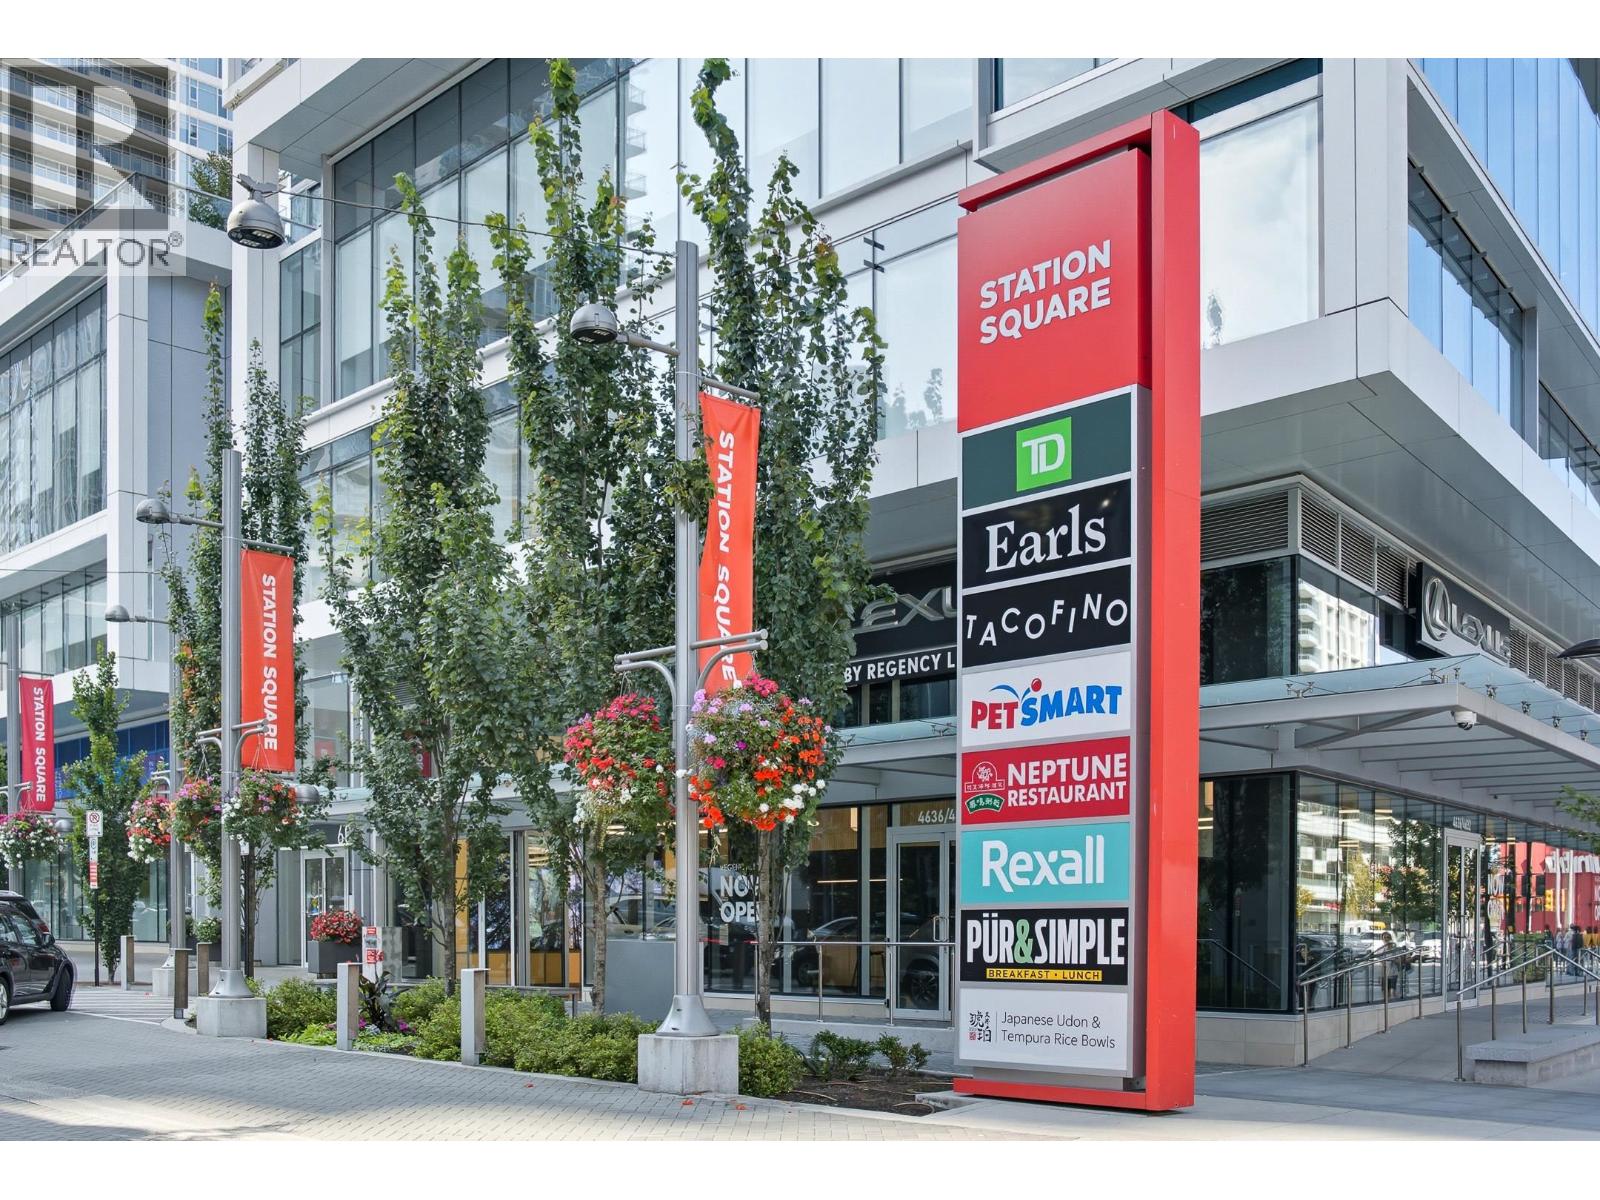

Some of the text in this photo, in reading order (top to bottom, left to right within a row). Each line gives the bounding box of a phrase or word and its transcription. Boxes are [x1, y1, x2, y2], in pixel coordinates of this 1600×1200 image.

[980, 239, 1112, 310] STATION
[979, 277, 1112, 344] SQUARE
[1022, 433, 1066, 475] TD
[715, 430, 735, 553] STATION
[985, 503, 1107, 573] Earls
[966, 593, 1128, 646] TACOFINO
[261, 573, 278, 750] STATION SQUARE
[843, 651, 955, 683] BY REGENCY L
[971, 684, 1122, 730] PETSMART
[33, 686, 47, 803] STATION SQUARE
[1007, 752, 1127, 787] NEPTUNE
[917, 807, 956, 824] 4636/4
[1007, 781, 1127, 807] RESTAURANT
[982, 835, 1105, 893] Rexall
[988, 969, 1100, 980] BREAKFAST LUNCH
[1001, 1011, 1054, 1028] Japanese
[1056, 1014, 1088, 1028] Udon
[1091, 1016, 1101, 1029] &
[1001, 1029, 1116, 1049] Tempura Rice Bowls
